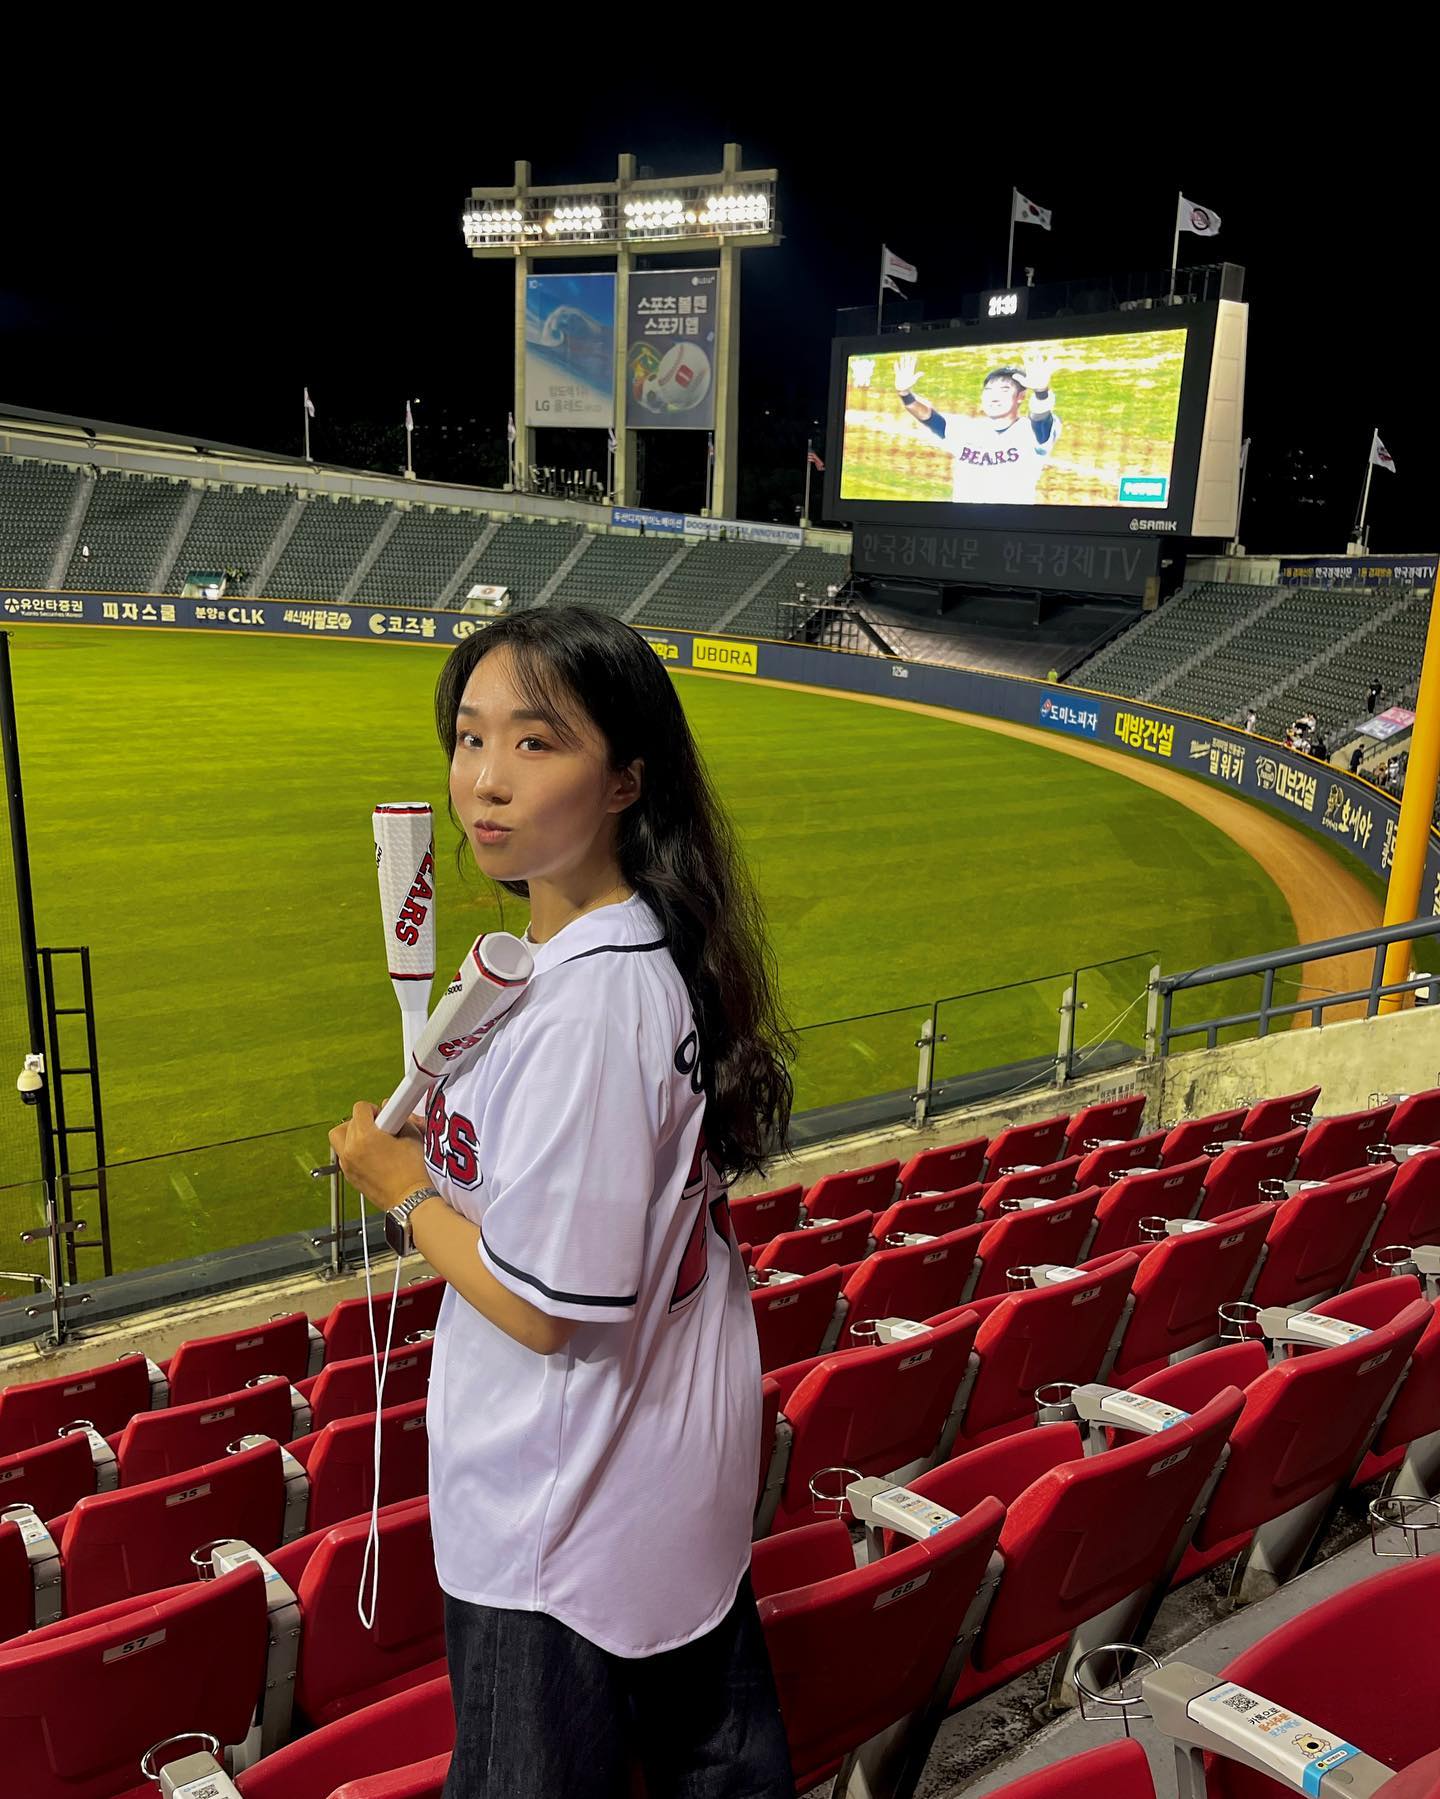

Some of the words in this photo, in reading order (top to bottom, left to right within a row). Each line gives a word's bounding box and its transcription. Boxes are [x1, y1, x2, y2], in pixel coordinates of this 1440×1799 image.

[637, 297, 677, 314] 스포츠
[644, 317, 684, 335] 스포키
[535, 399, 550, 412] LG
[959, 446, 1021, 468] BEARS
[1139, 519, 1177, 531] SAMIK
[861, 533, 980, 571] 한국경제신문
[1002, 540, 1142, 582] 한국경제TV
[20, 599, 84, 612] 유안타증권
[227, 607, 265, 625] CLK
[696, 645, 753, 667] UBORA
[1049, 705, 1098, 731] 도미노피자
[1114, 712, 1175, 758] 대방건설
[1210, 749, 1244, 785] 밀워키
[1275, 762, 1318, 813] 대보건설
[210, 1410, 226, 1420] 25
[178, 1487, 199, 1502] 35
[891, 1581, 915, 1599] 68
[122, 1637, 149, 1654] 57
[1247, 1707, 1281, 1725] 카톡으로
